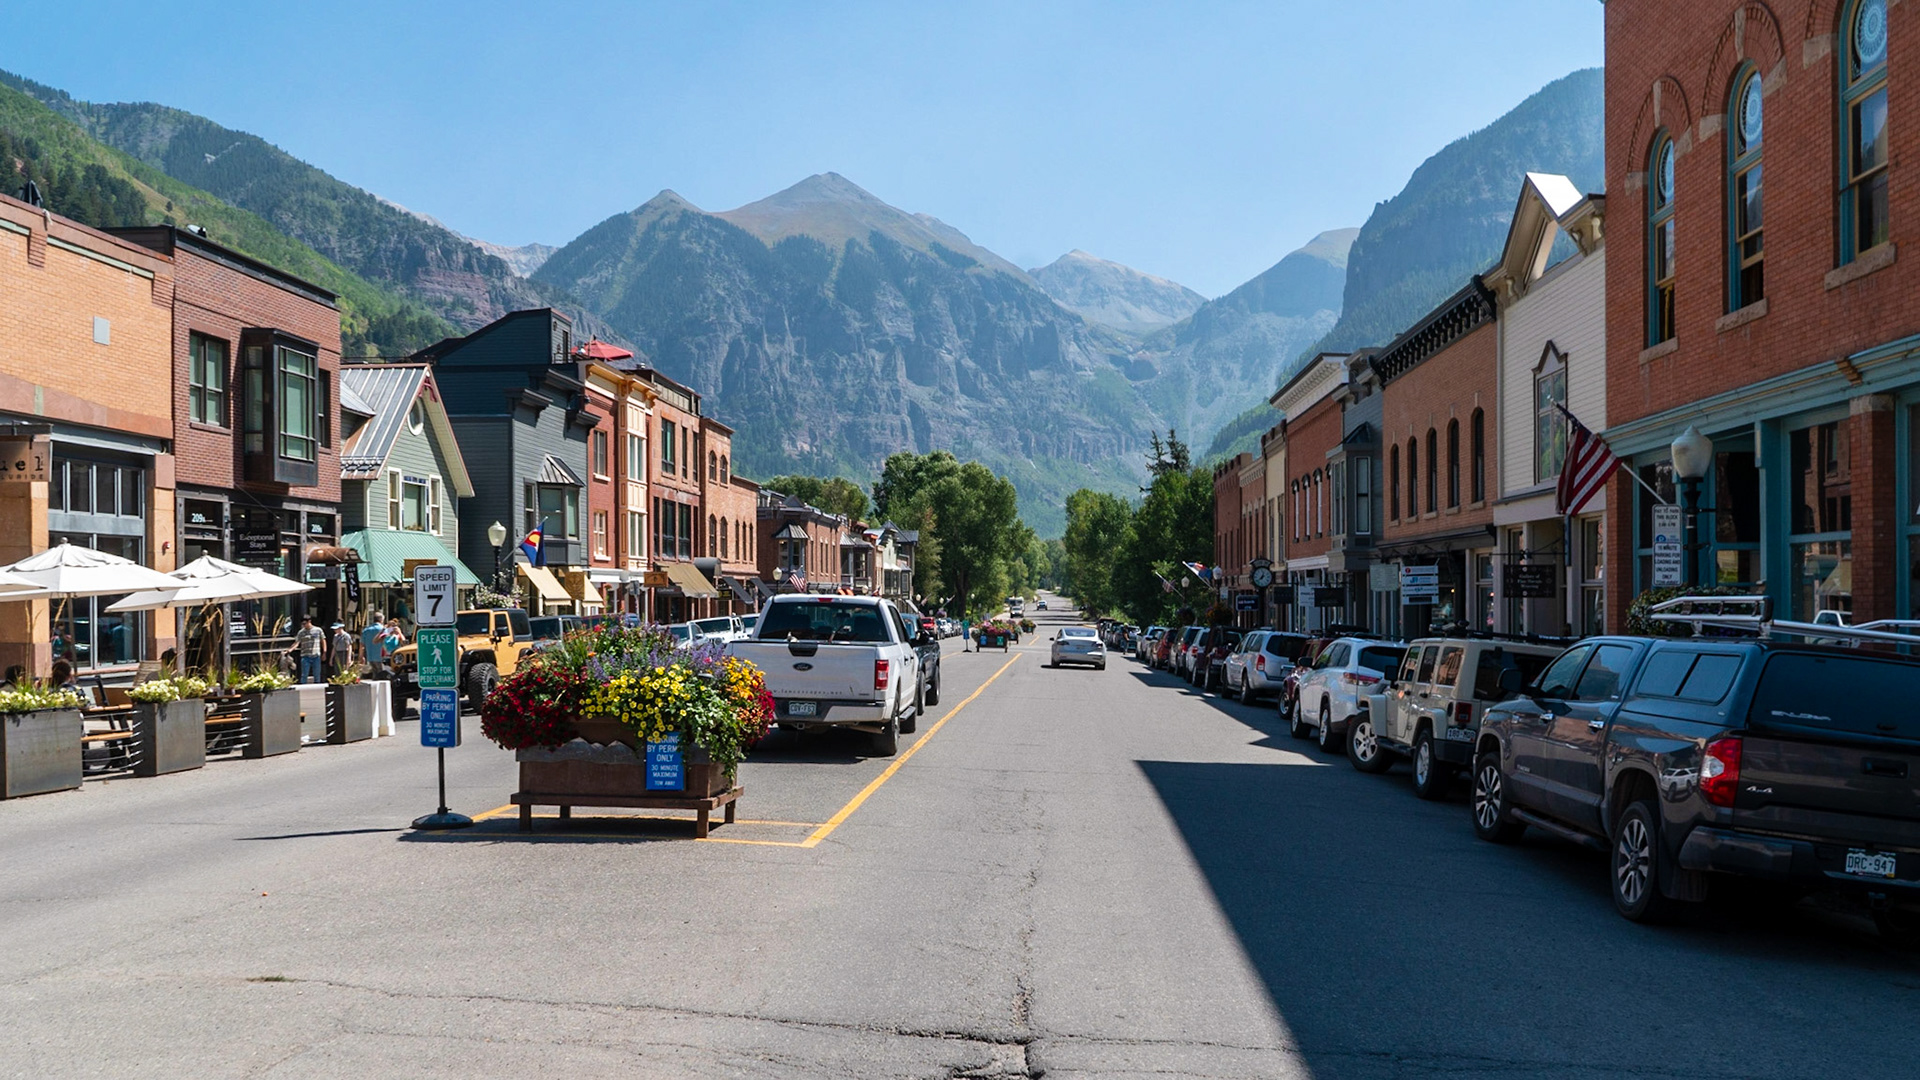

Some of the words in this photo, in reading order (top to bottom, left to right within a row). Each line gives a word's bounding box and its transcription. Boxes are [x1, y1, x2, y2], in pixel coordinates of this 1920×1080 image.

[239, 533, 275, 541] Exceptional
[249, 541, 266, 549] Stays
[419, 573, 451, 581] SPEED
[427, 595, 443, 616] 7
[421, 635, 451, 644] PLEASE
[420, 675, 454, 683] PEDESTRIANS
[425, 694, 451, 702] PARKING
[656, 754, 673, 762] ONLY
